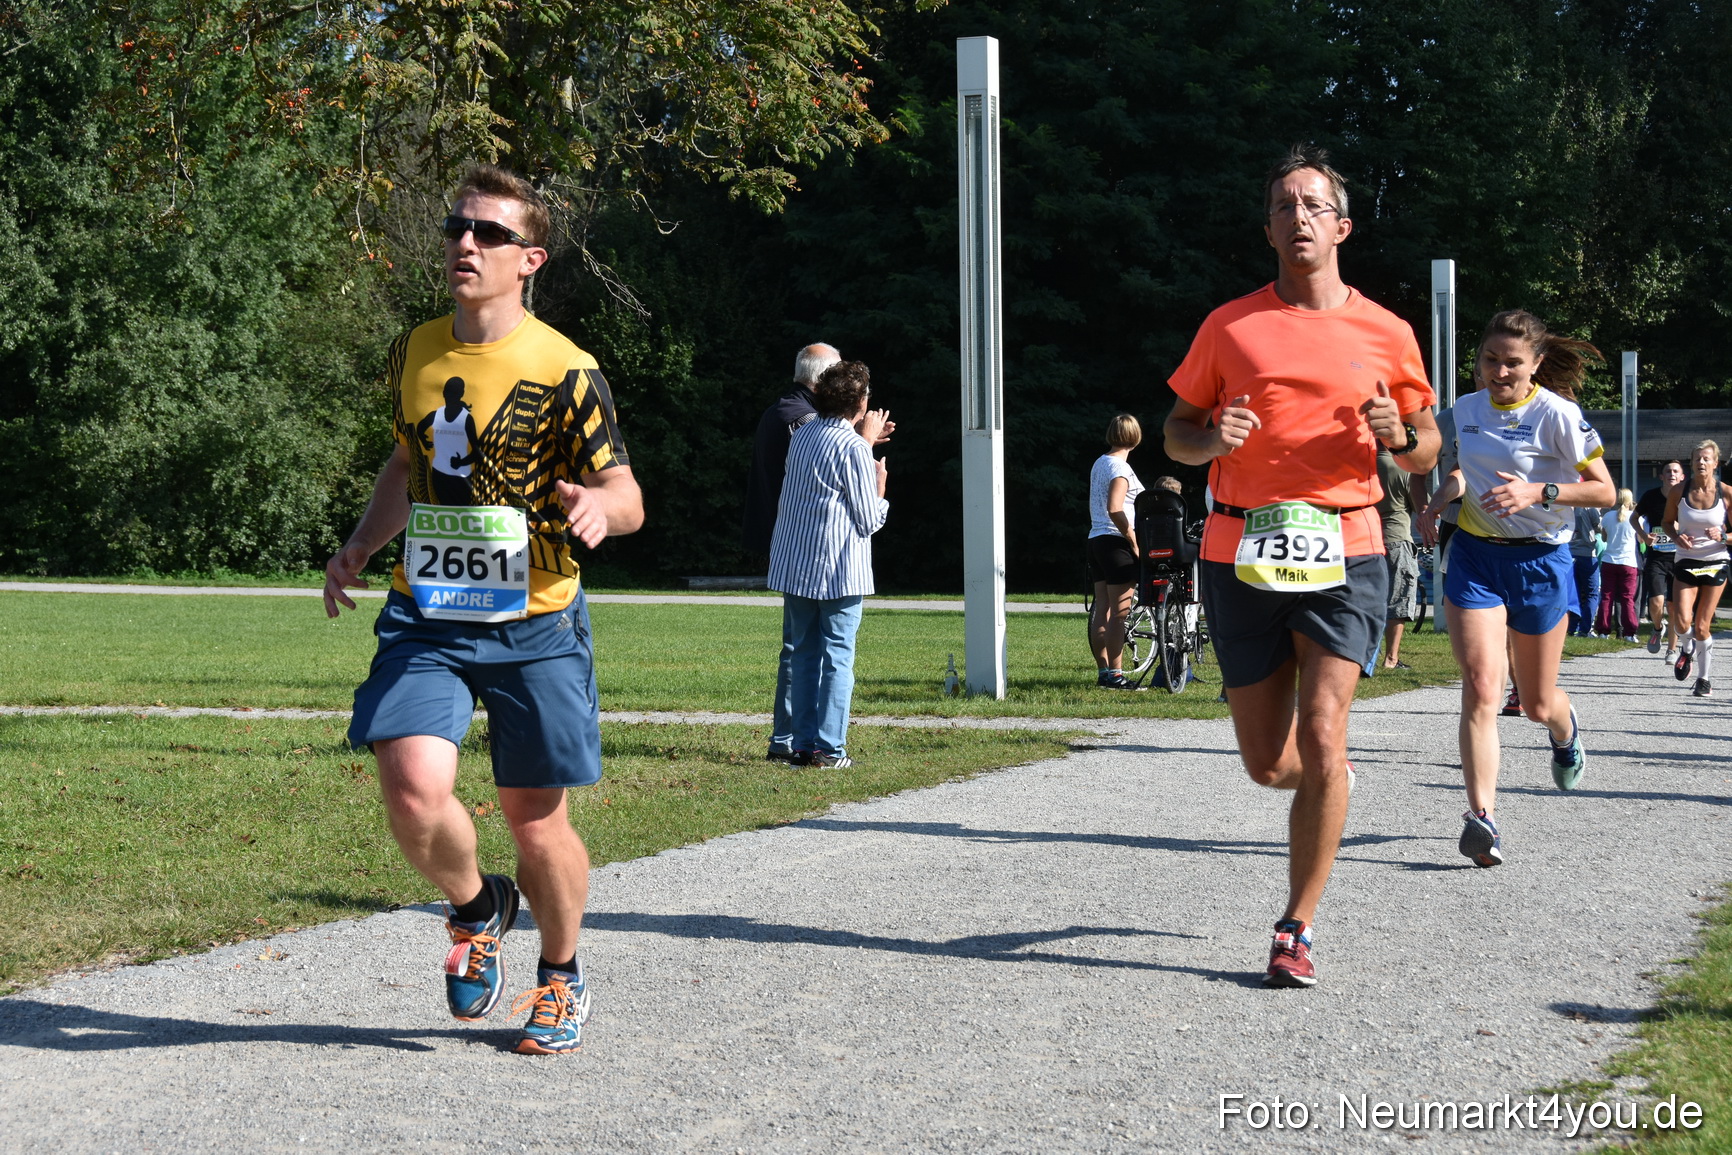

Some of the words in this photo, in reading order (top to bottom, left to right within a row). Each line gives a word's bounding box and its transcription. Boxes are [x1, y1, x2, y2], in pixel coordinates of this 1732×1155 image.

[520, 385, 544, 395] nutella
[514, 408, 536, 418] duplo
[414, 511, 512, 535] BOCK
[1253, 506, 1328, 530] BOCK
[1253, 534, 1330, 562] 1392
[417, 545, 508, 582] 2661
[1275, 568, 1309, 582] Maik
[428, 590, 495, 608] ANDRÉ
